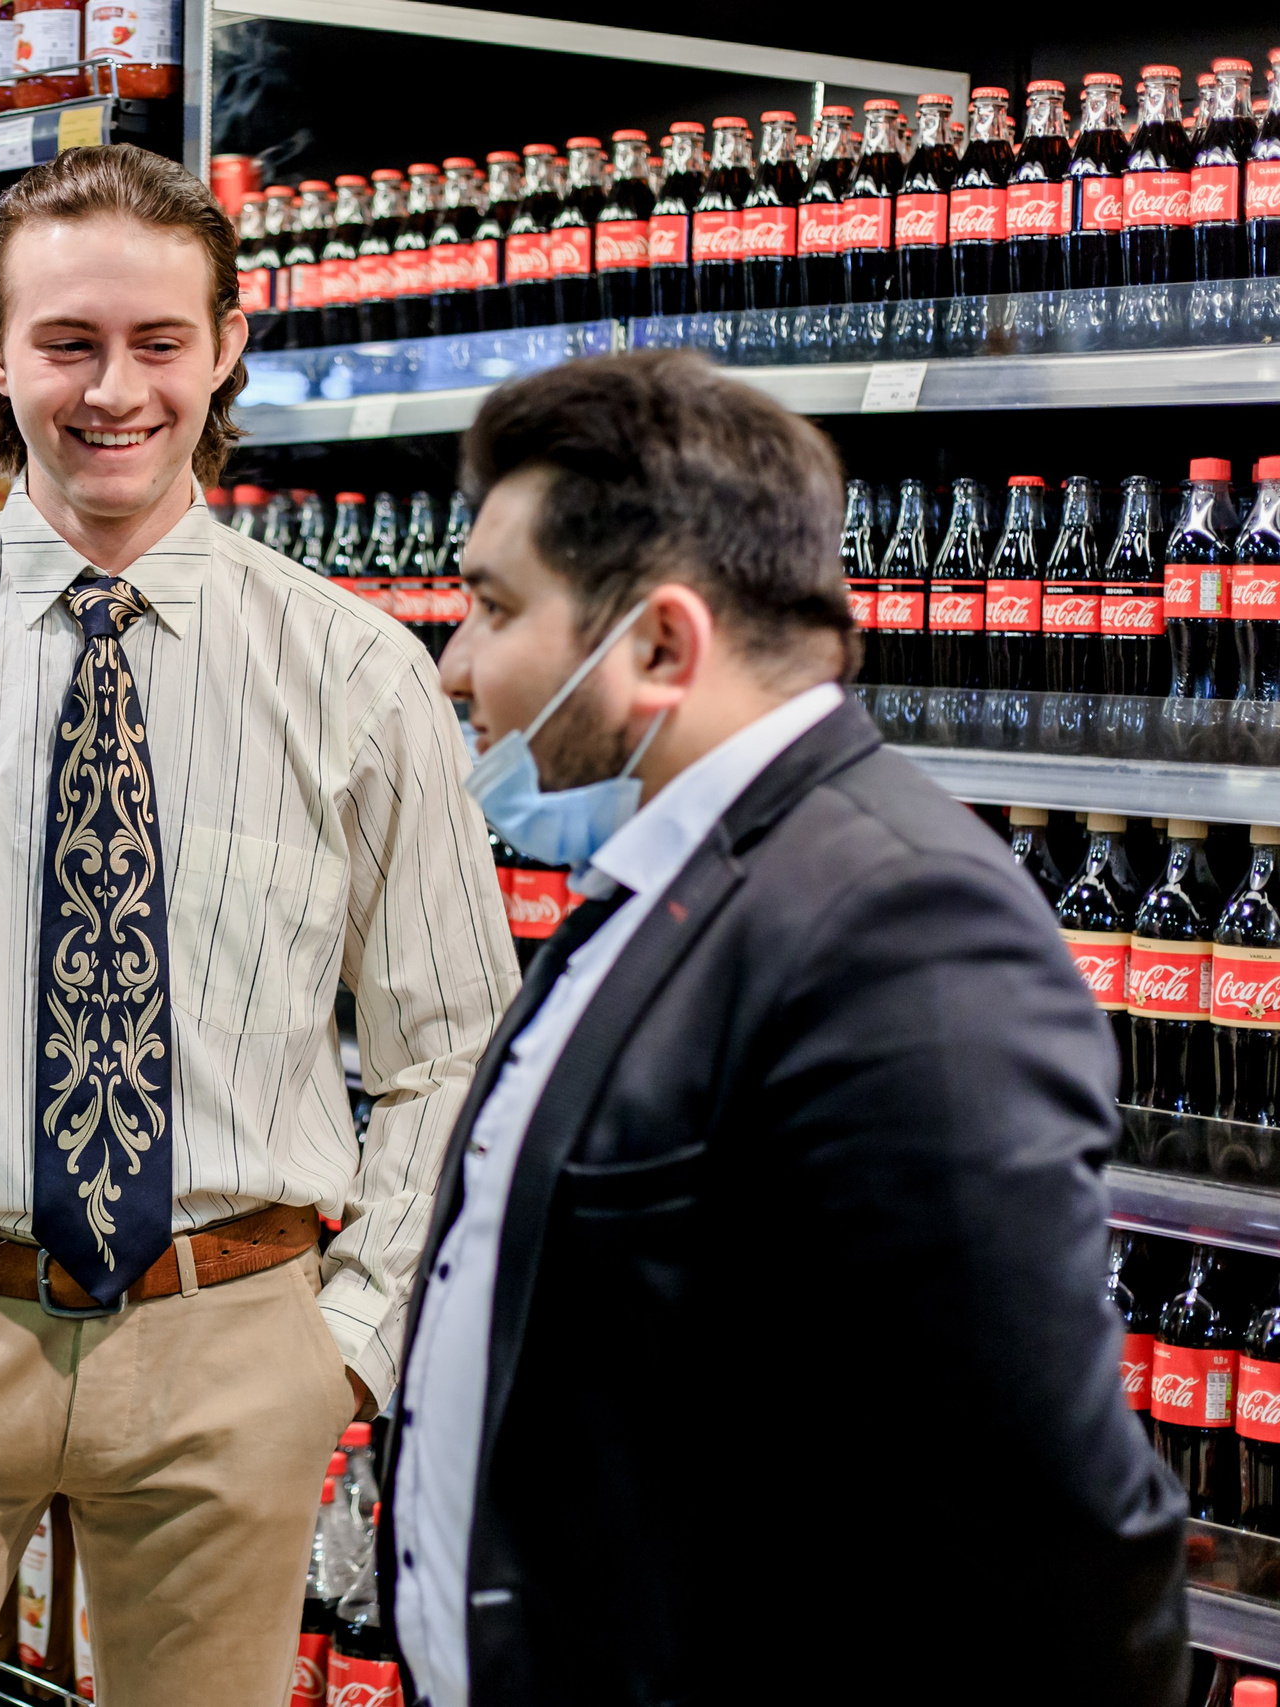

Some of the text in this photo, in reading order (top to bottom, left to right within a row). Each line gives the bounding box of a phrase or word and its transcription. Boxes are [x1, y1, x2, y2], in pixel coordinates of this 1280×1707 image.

[1153, 177, 1180, 185] CLASSIC
[1128, 190, 1192, 218] Coca-Col
[1130, 964, 1196, 1002] ca-Cola
